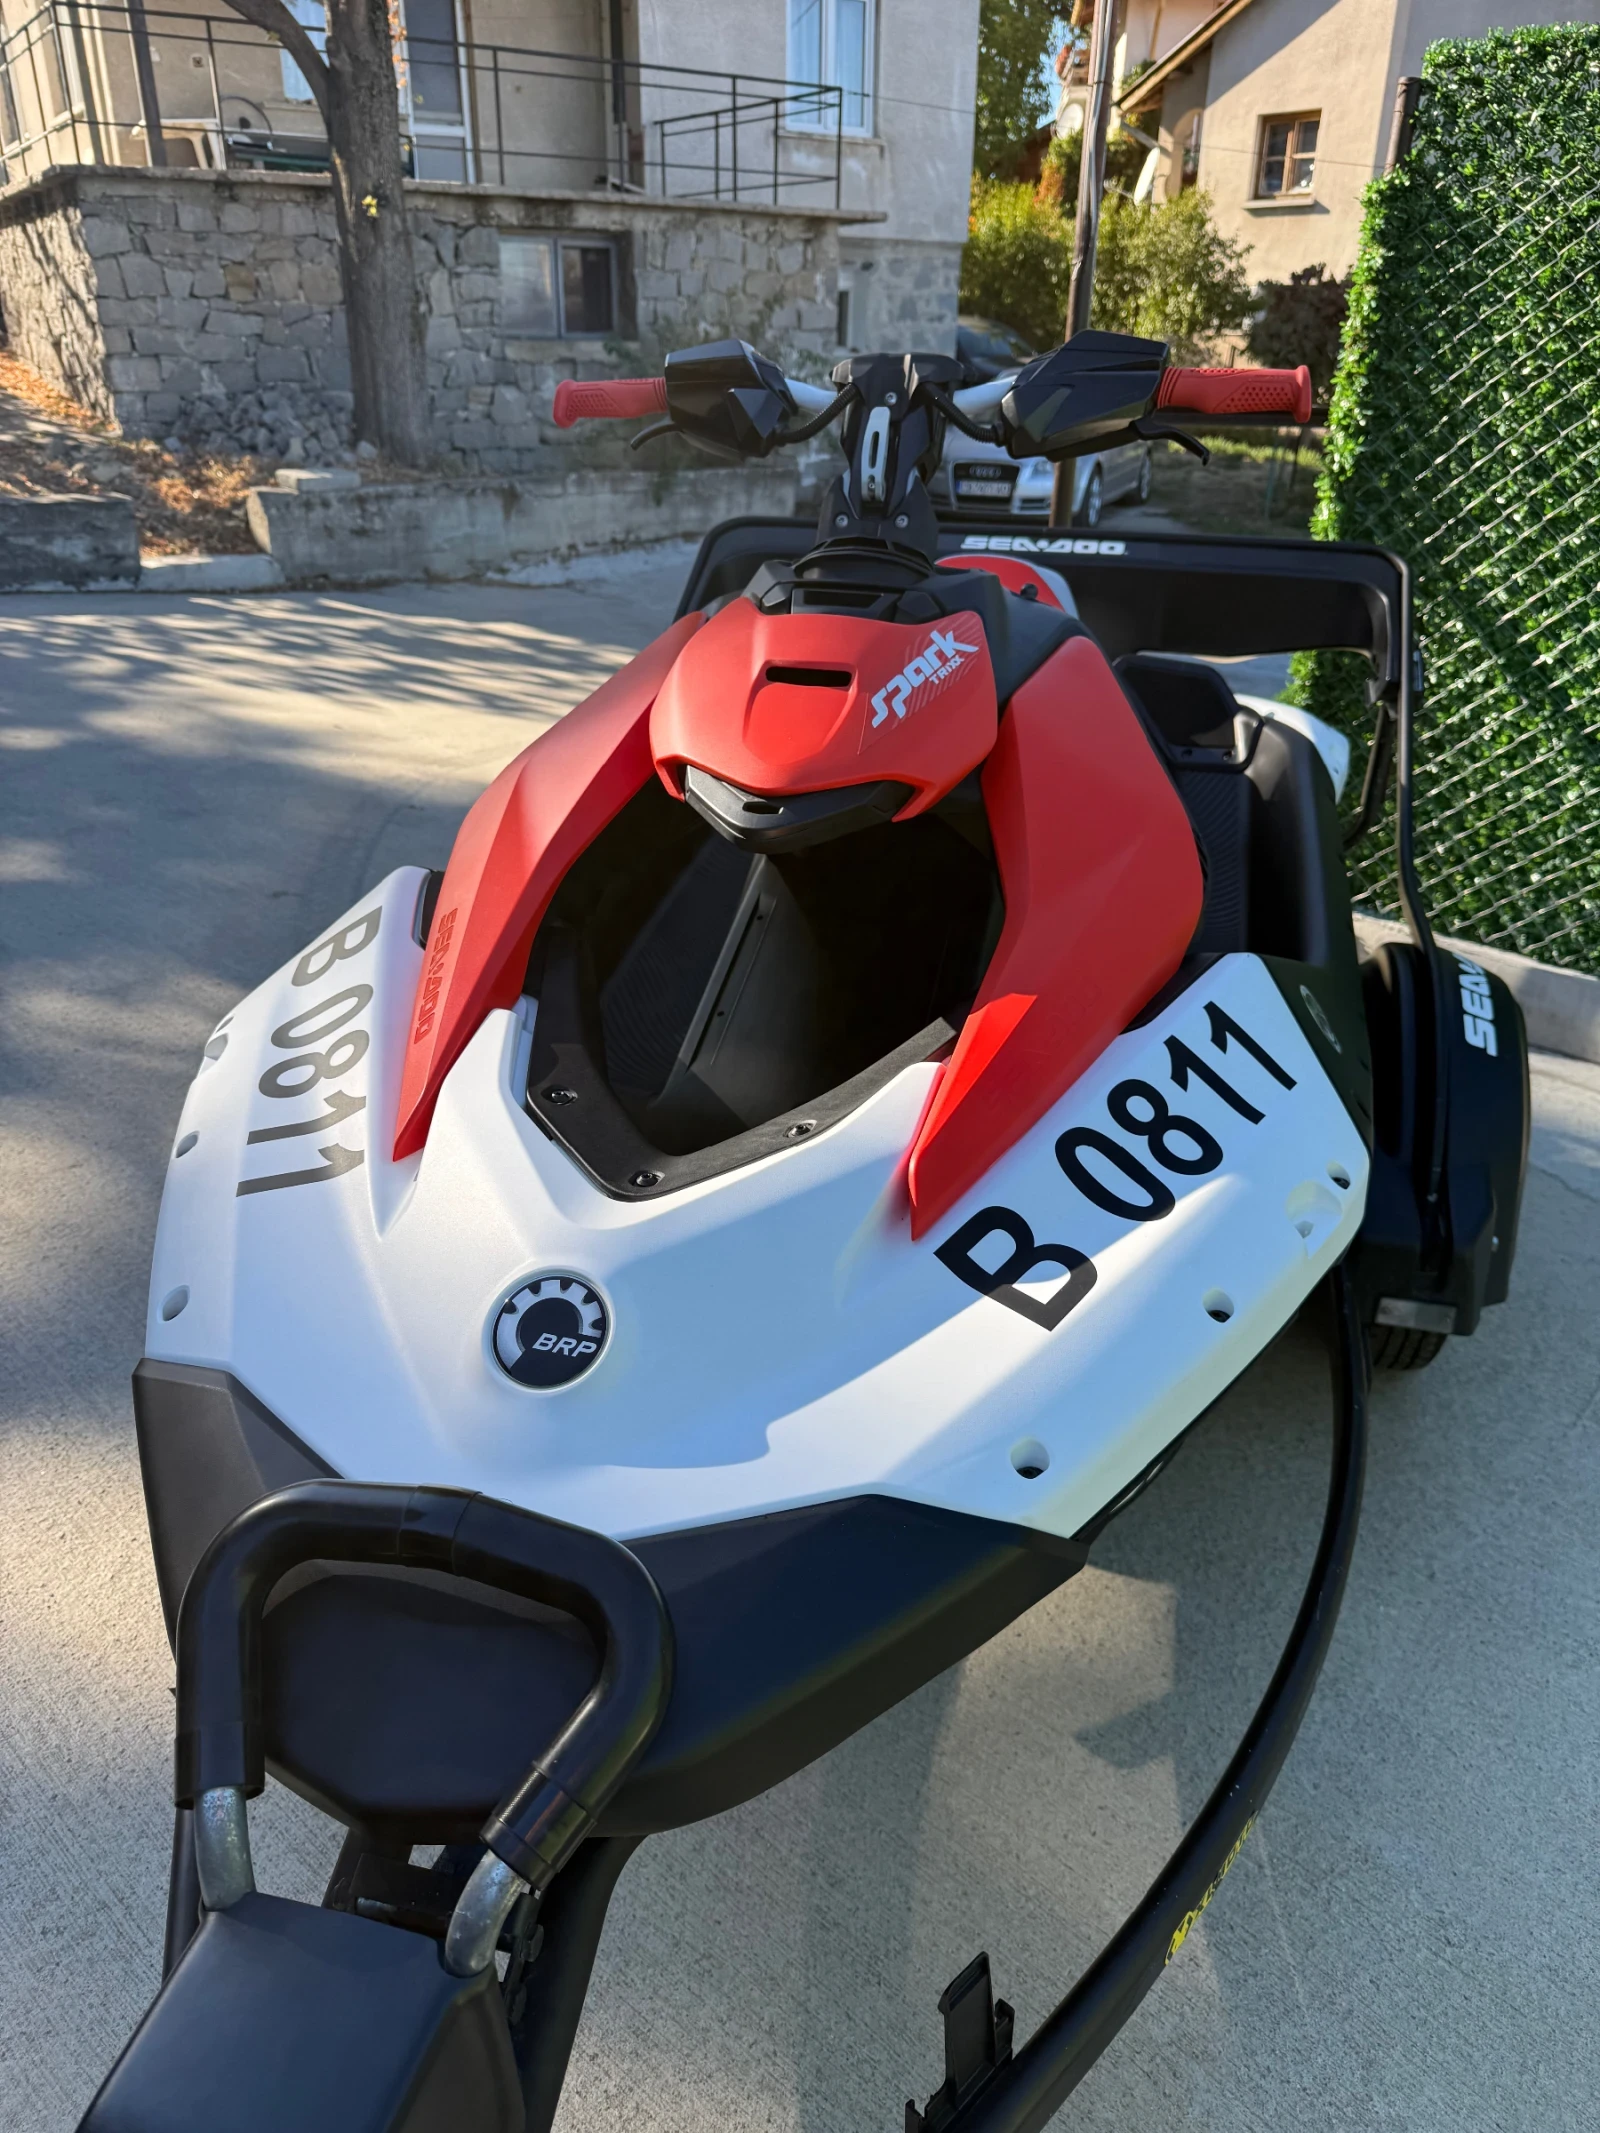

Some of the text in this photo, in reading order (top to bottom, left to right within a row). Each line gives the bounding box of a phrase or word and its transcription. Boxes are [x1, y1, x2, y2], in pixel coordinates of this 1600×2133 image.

[236, 905, 383, 1197] B 0811
[933, 1001, 1298, 1332] B 0811
[532, 1332, 598, 1357] BRP
